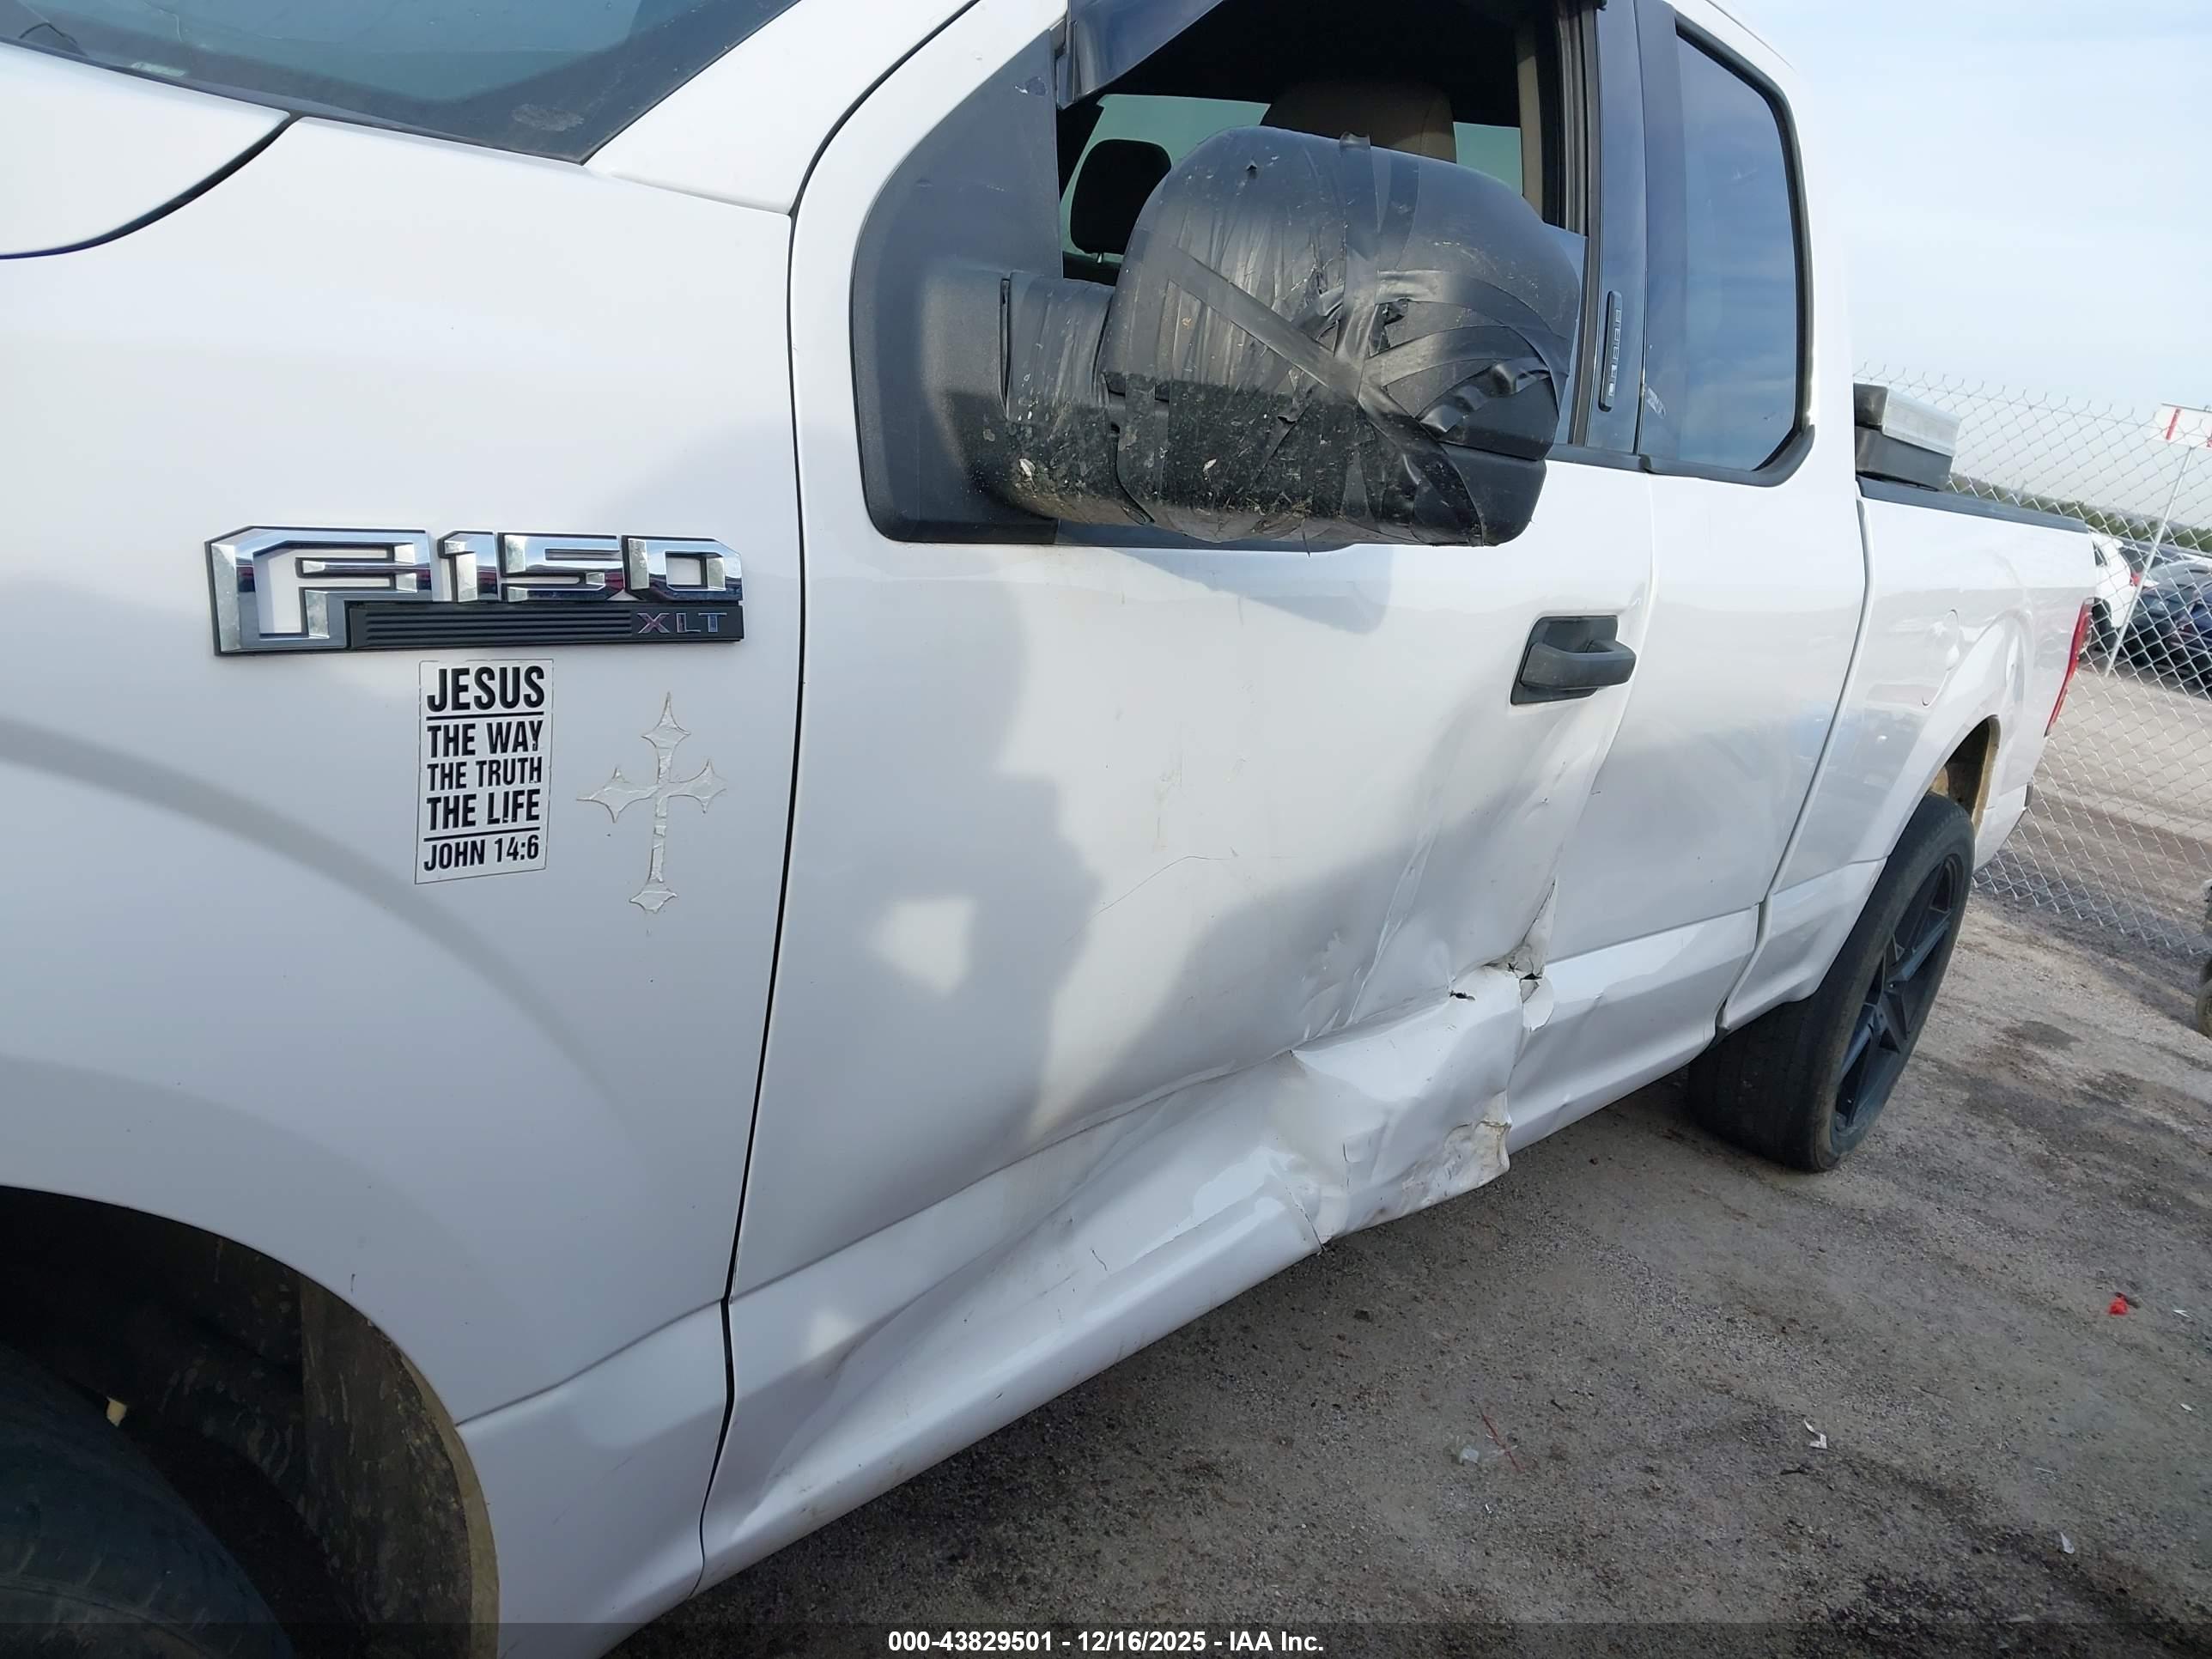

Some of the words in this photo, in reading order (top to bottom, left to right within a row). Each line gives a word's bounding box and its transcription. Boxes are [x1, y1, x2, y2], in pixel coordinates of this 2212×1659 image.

[636, 611, 727, 635] XLT
[427, 666, 544, 712] JESUS
[427, 724, 477, 757] THE
[487, 720, 544, 755] WAY
[427, 762, 468, 791] THE
[475, 757, 543, 788] TRUTH
[426, 794, 477, 830] THE
[487, 789, 541, 825] LIFE
[423, 840, 486, 871] JOHN
[494, 834, 540, 863] 14:6
